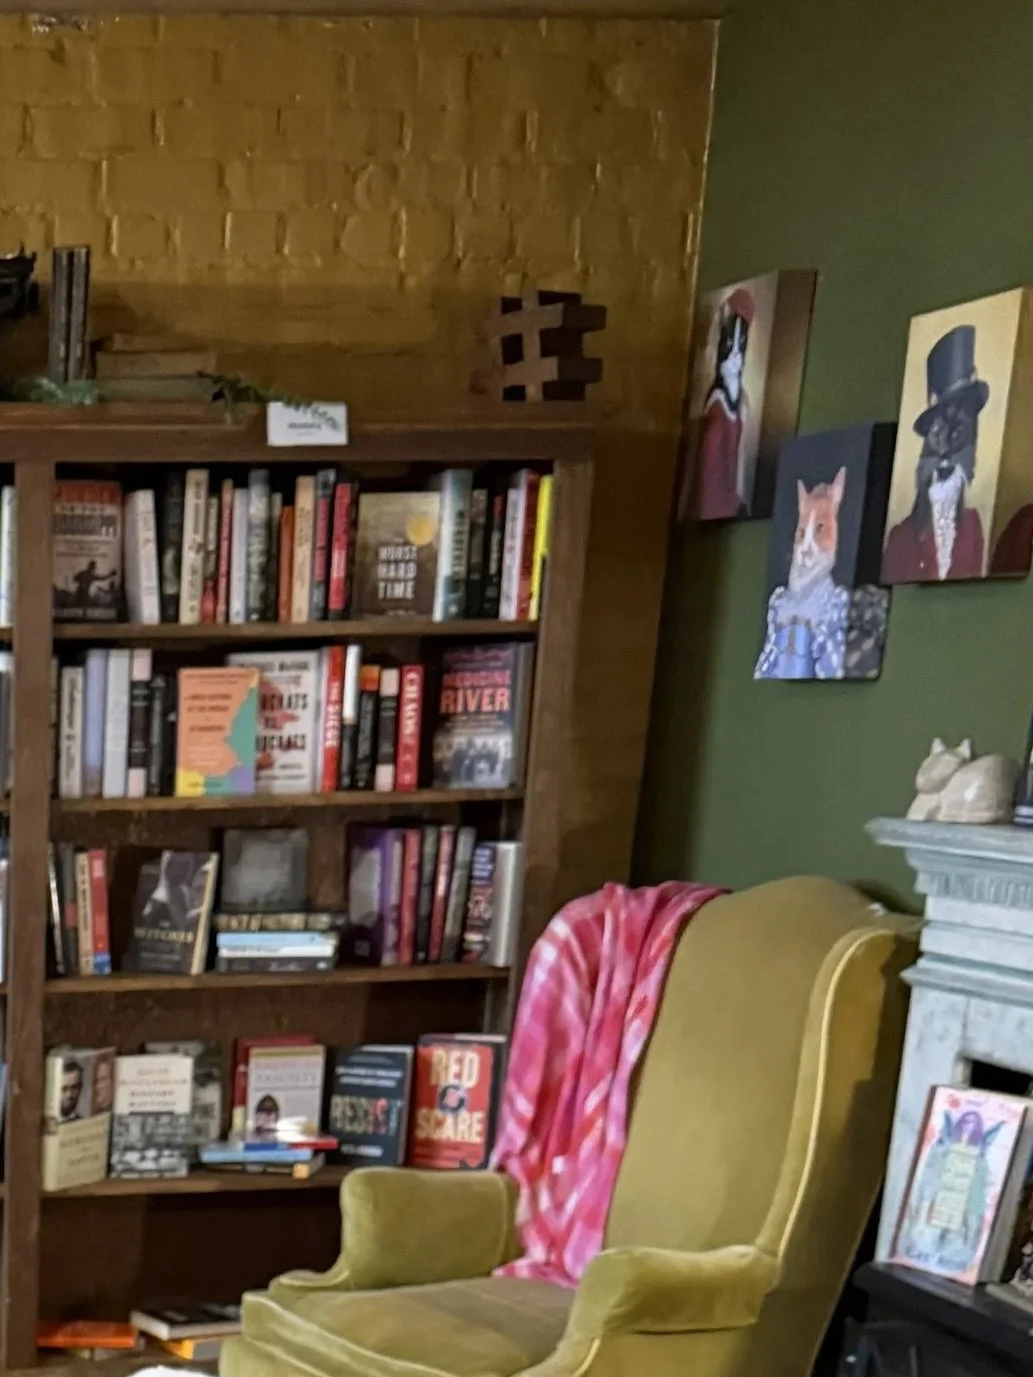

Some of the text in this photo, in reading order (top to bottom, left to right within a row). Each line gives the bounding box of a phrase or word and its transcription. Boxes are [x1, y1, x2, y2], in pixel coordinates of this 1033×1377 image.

[378, 580, 416, 599] TIME
[440, 687, 511, 715] RIVER
[133, 926, 196, 943] WITCHES
[430, 1050, 480, 1088] RED
[417, 1107, 484, 1143] SCARE
